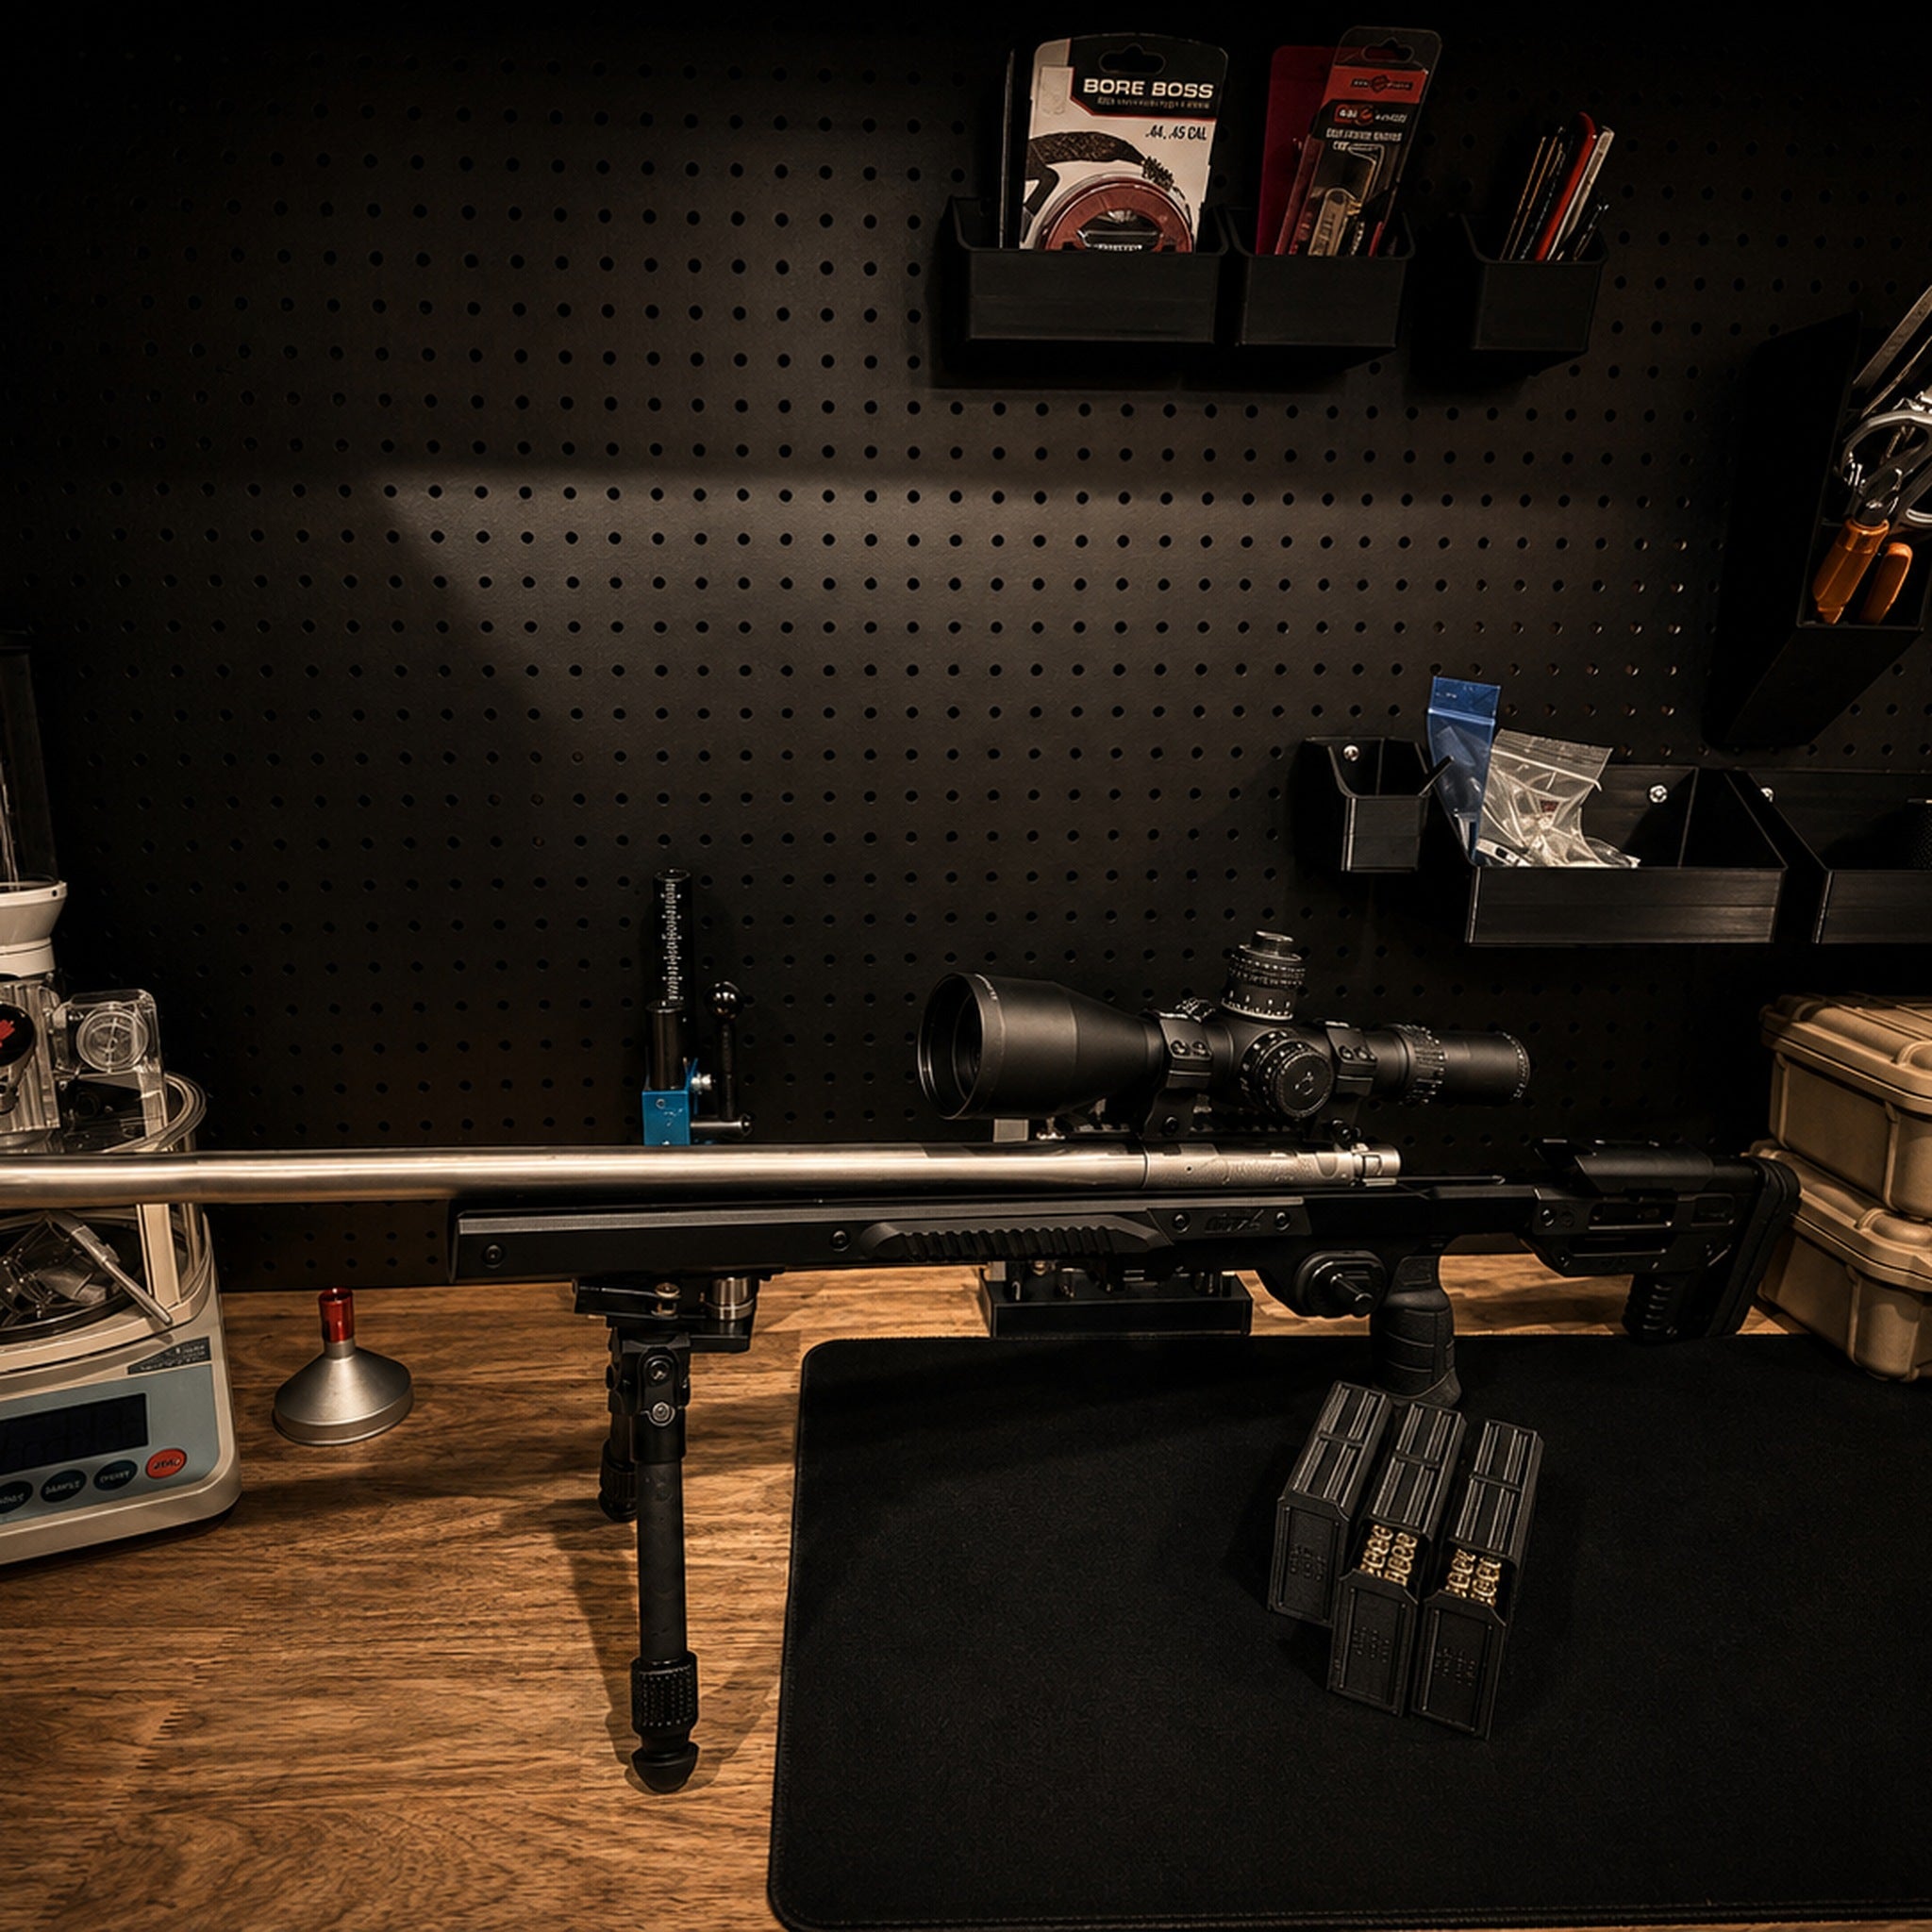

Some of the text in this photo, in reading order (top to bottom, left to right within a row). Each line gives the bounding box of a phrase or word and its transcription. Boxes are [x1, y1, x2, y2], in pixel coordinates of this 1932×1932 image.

[1083, 78, 1214, 99] BORE BOSS
[1187, 125, 1208, 141] CAL
